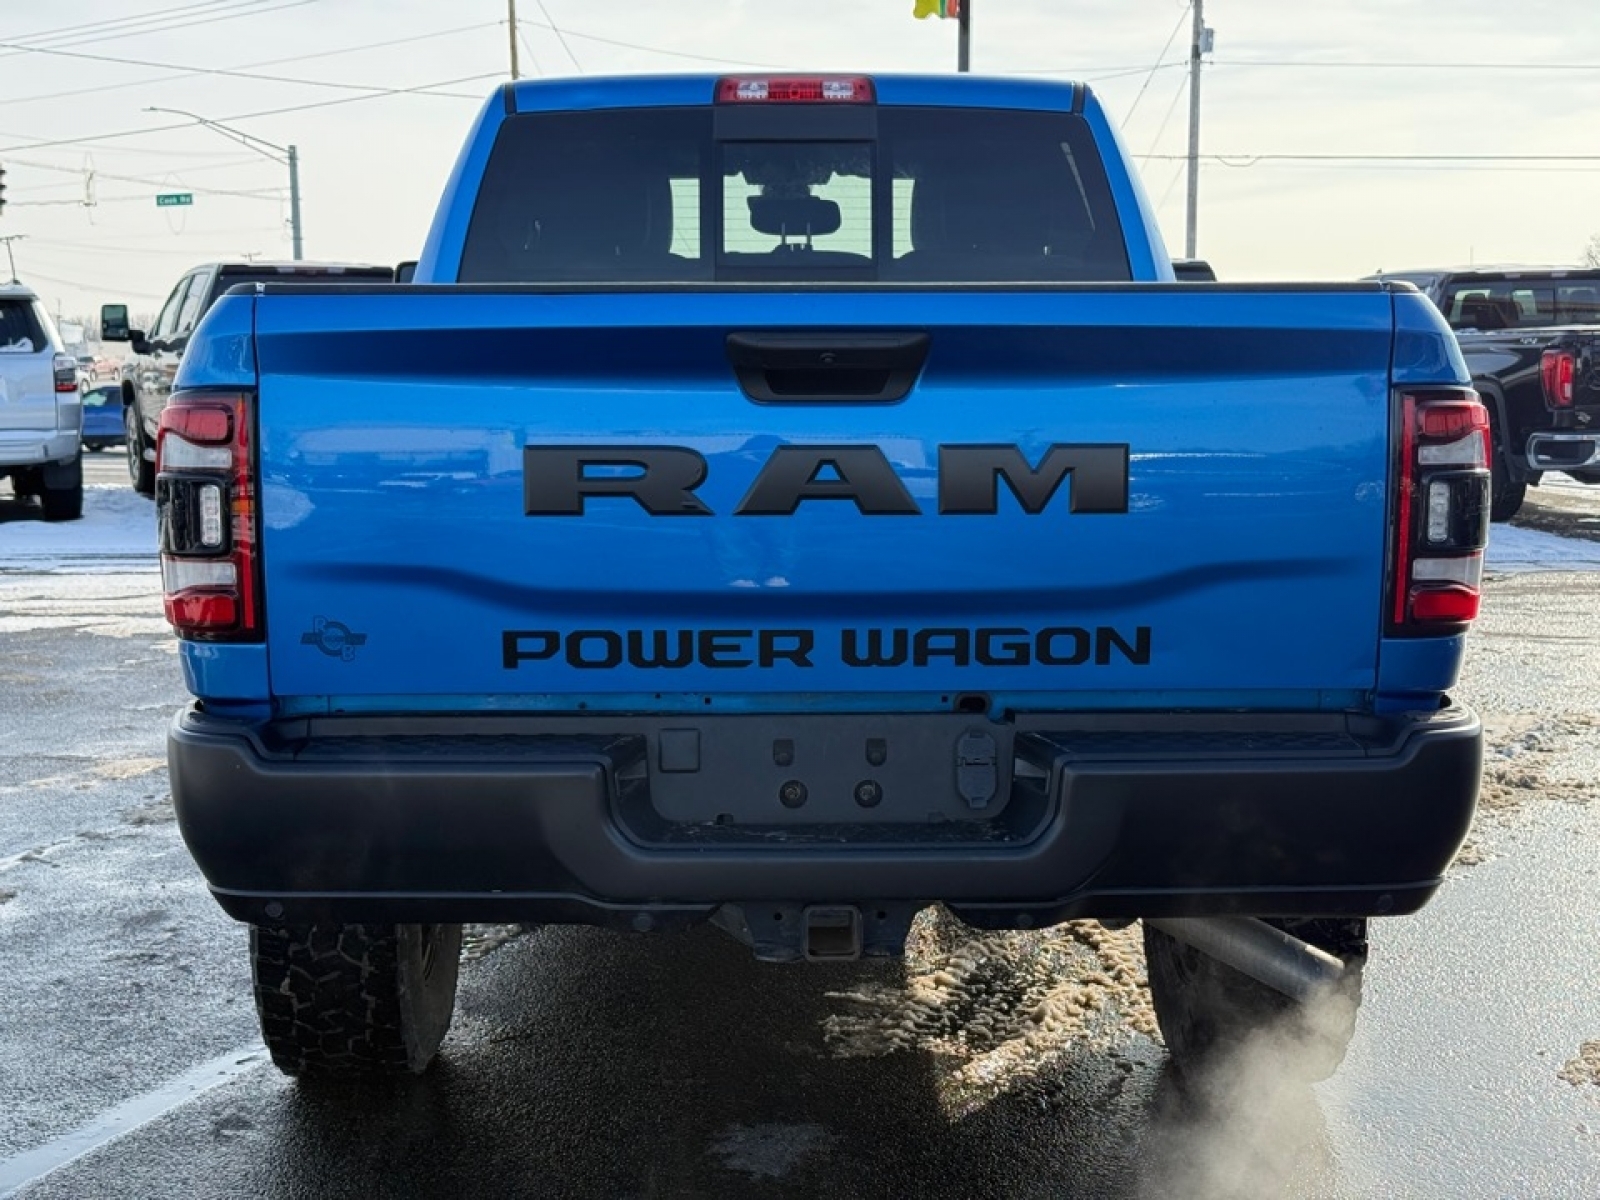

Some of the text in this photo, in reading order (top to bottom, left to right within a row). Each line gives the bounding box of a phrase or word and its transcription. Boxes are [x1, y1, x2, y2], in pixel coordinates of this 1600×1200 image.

[523, 443, 1130, 516] RAM
[503, 627, 1151, 670] POWER WAGON
